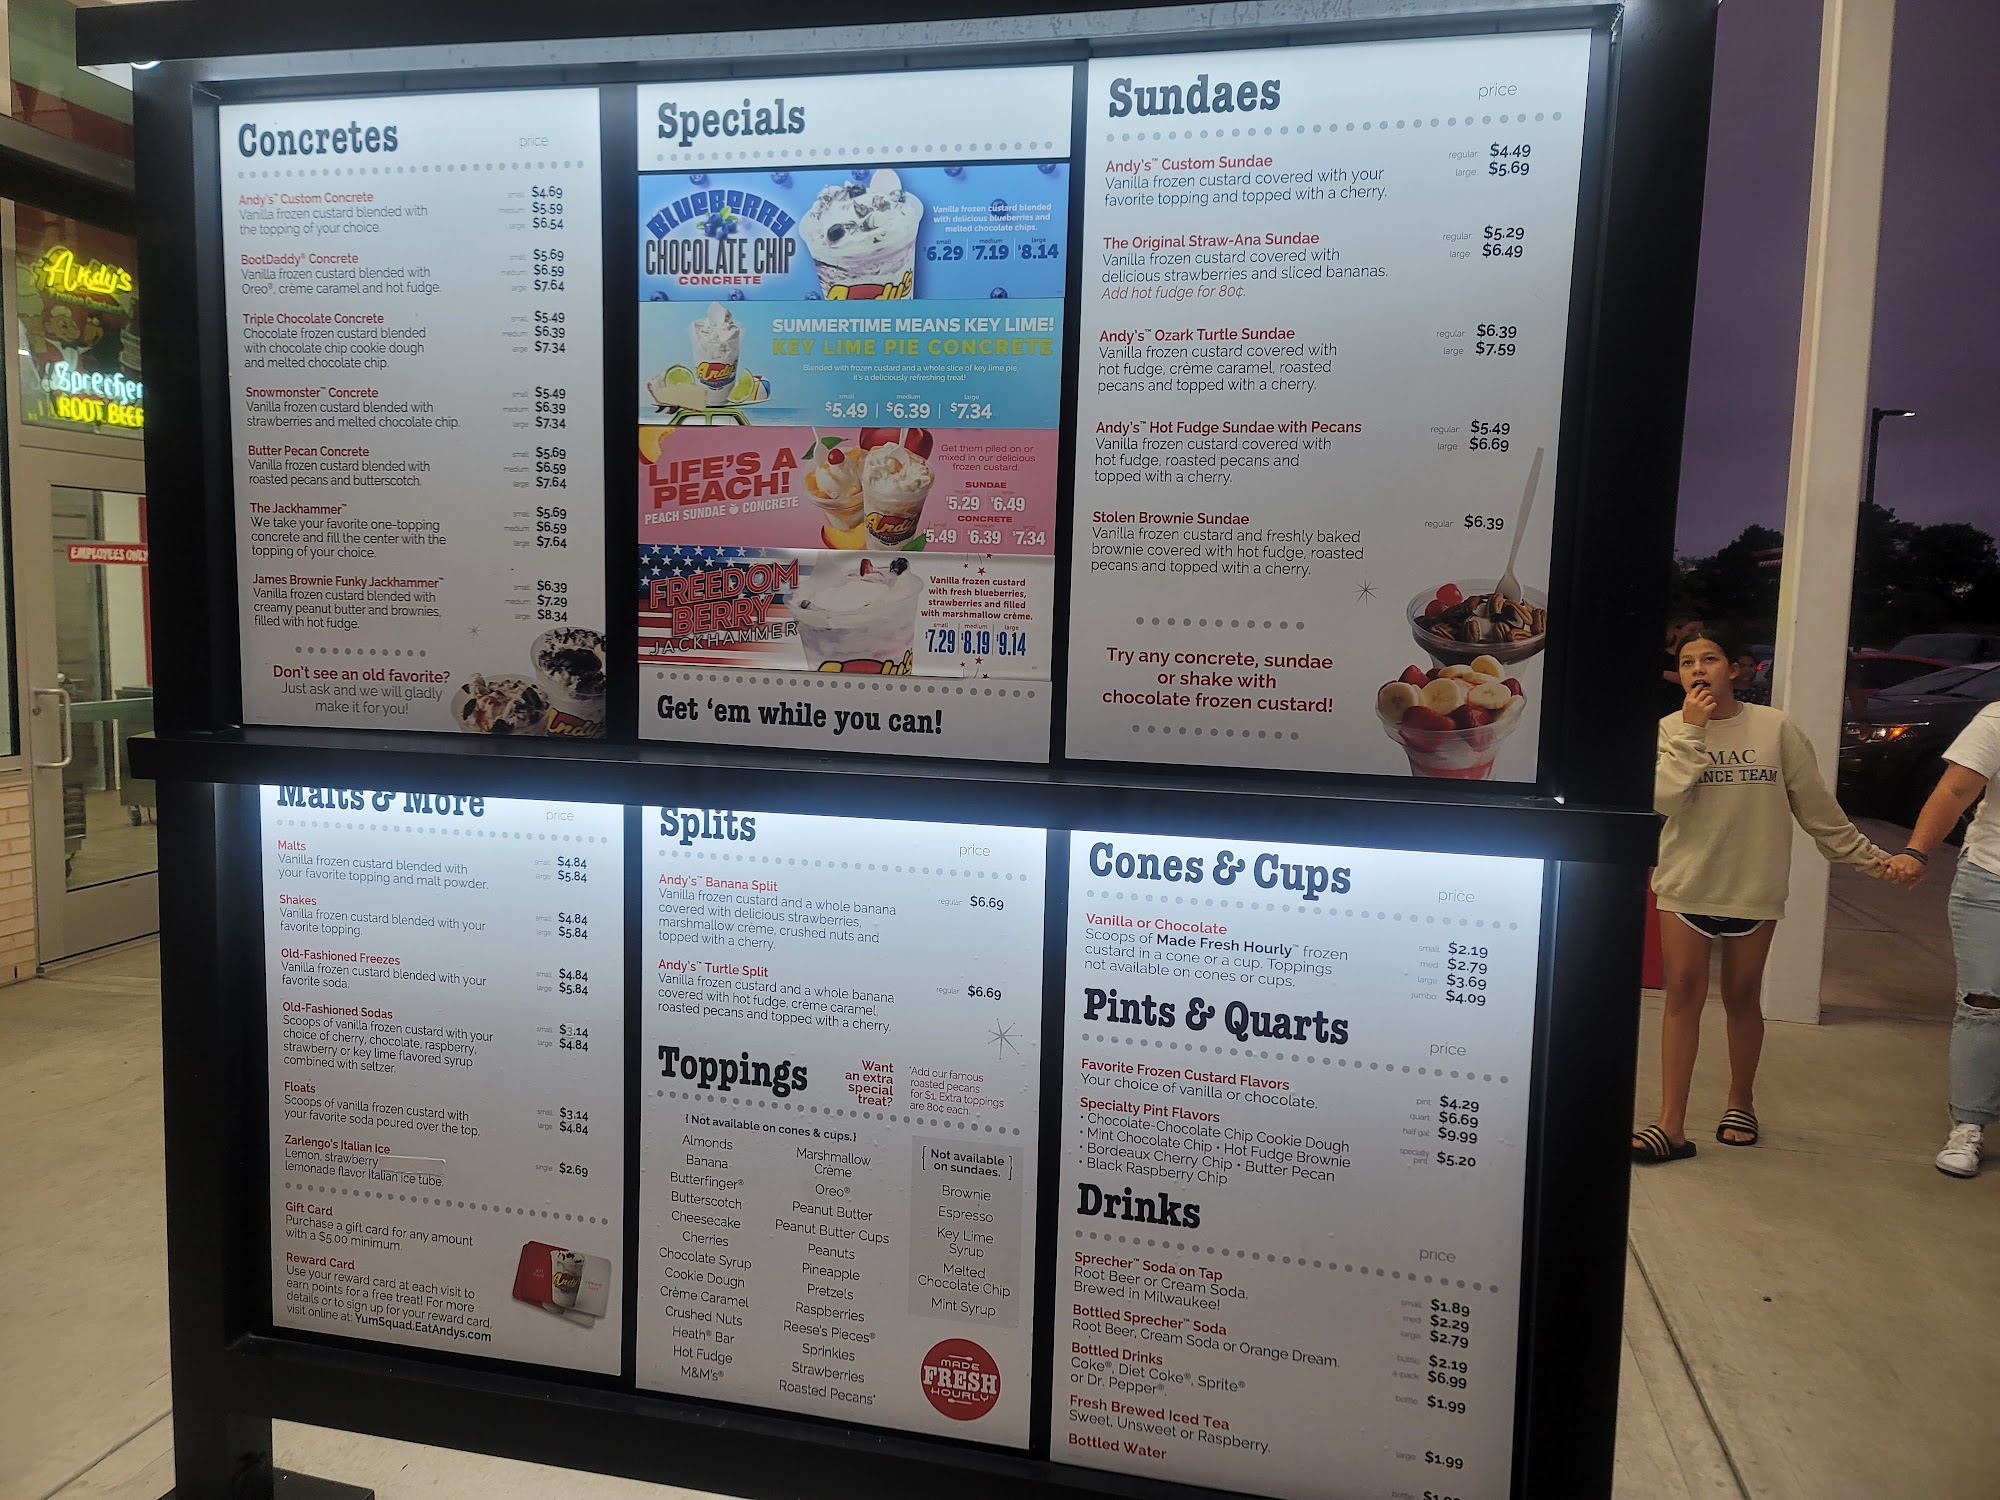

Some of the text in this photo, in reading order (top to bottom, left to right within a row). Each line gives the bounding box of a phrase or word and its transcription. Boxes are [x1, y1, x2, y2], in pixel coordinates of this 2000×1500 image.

[1108, 74, 1517, 118] Sundaes price
[657, 98, 805, 147] Specials
[238, 120, 548, 157] Concretes price
[646, 189, 796, 240] BLUEBERRY
[1103, 231, 1320, 250] The Original Straw-Ana Sundae
[1483, 225, 1525, 242] $5.29
[645, 237, 796, 275] CHOCOLATE CHIP
[923, 244, 1059, 261] $6.29 $7.19 $8.14
[1482, 242, 1523, 259] $6.49
[43, 250, 133, 294] Andy's
[678, 275, 761, 285] CONCRETE
[1101, 285, 1127, 299] Add
[1130, 285, 1152, 299] hot
[1155, 284, 1194, 301] fudge
[1197, 284, 1215, 298] for
[243, 312, 384, 325] Triple Chocolate Concrete
[534, 310, 565, 325] $5.49
[772, 318, 1055, 333] SUMMERTIME MEANS KEY LIME!
[243, 327, 426, 339] Chocolate frozen custard blended
[534, 325, 565, 340] $6.39
[244, 342, 424, 356] with chocolate chip cookie dough
[534, 341, 565, 355] $7.34
[773, 339, 1053, 355] KEY LIME PIE CONCRETE
[245, 357, 389, 371] and melted chocolate chip.
[58, 396, 104, 421] ROOT
[825, 402, 993, 419] $5.49 $6.39 $7.34
[248, 446, 369, 457] Butter Pecan Concrete
[648, 447, 798, 486] LIFE'S A
[654, 472, 790, 509] PEACH!
[965, 481, 1007, 489] SUNDAE
[644, 497, 799, 525] PEACH SUNDAE CONCRETE
[946, 496, 1026, 512] $5.29 $6.49
[1092, 511, 1250, 526] Stolen Brownie Sundae
[1424, 514, 1504, 531] regular $6.39
[71, 547, 124, 560] EMPLOYEES
[649, 558, 800, 609] FREEDOM
[672, 594, 775, 637] BERRY
[648, 621, 798, 656] JACKHAMMER
[925, 629, 1026, 656] $7.29 $8.19 $9.14
[1107, 647, 1334, 670] Try any concrete, sundae
[273, 666, 450, 683] Don't see an old favorite?
[1157, 670, 1277, 689] or shake with
[1102, 689, 1334, 713] chocolate frozen custard!
[657, 695, 698, 721] Get
[759, 701, 826, 728] while
[834, 707, 881, 734] you
[888, 710, 943, 734] can!
[1708, 750, 1756, 765] MAC
[1695, 769, 1777, 784] ANCE TEAM
[277, 786, 575, 823] Malts & More price
[660, 807, 990, 858] Splits price
[278, 841, 306, 851] Malts
[558, 856, 587, 869] $4.84
[558, 870, 588, 883] $5.84
[1089, 841, 1475, 904] Cones & Cups price
[279, 895, 317, 906] Shakes
[1448, 942, 1489, 959] $2.19
[1447, 958, 1488, 975] $2.79
[1446, 974, 1487, 991] $3.69
[1446, 990, 1486, 1007] $4.09
[1083, 987, 1349, 1045] Pints & Quarts
[658, 1045, 808, 1097] Toppings
[861, 1059, 894, 1072] Want
[845, 1071, 894, 1084] an extra
[848, 1082, 894, 1097] special
[858, 1094, 893, 1107] treat?
[682, 1135, 733, 1150] Almonds
[686, 1154, 728, 1170] Banana
[671, 1191, 742, 1210] Butterscotch
[941, 1184, 991, 1201] Brownie
[938, 1205, 994, 1223] Espresso
[1077, 1182, 1201, 1230] Drinks
[671, 1211, 741, 1229] Cheesecake
[682, 1231, 729, 1247] Cherries
[802, 1263, 860, 1282] Pineapple
[355, 1312, 492, 1342] YumSquad.EatAndys.com
[1071, 1341, 1163, 1365] Bottled Drinks
[940, 1358, 980, 1371] MADE
[923, 1365, 998, 1396] FRESH
[1068, 1433, 1167, 1460] Bottled Water
